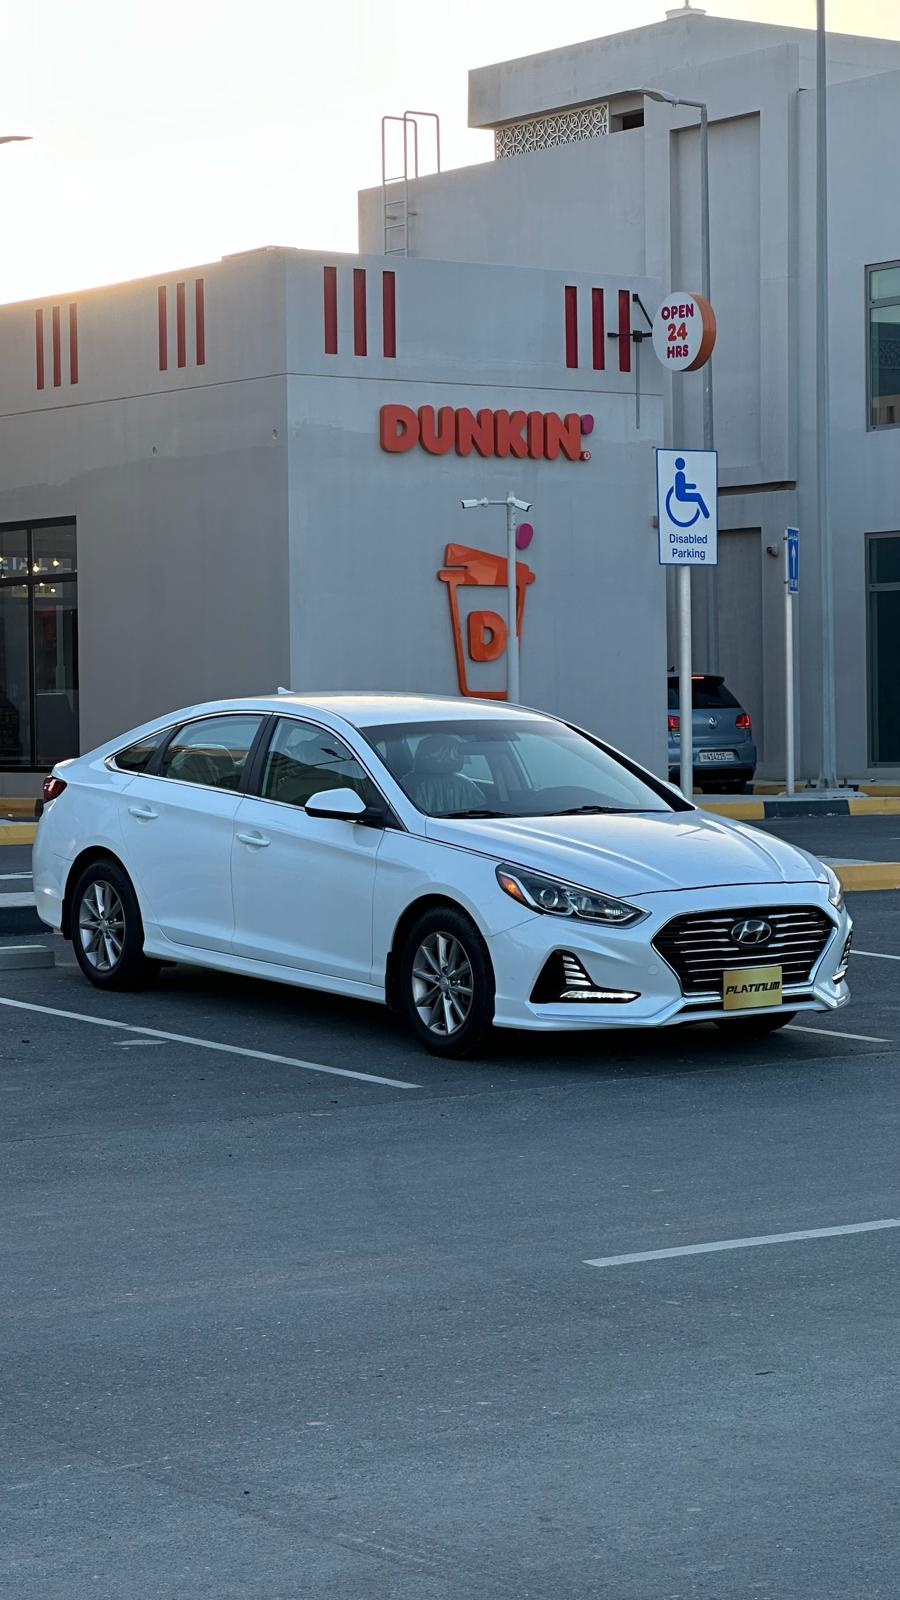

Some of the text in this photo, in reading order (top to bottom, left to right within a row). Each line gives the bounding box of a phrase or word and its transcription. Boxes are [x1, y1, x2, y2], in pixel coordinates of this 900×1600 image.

[661, 303, 694, 320] OPEN
[667, 322, 688, 341] 24
[667, 345, 689, 359] HRS
[669, 533, 708, 544] Disabled
[672, 548, 706, 560] Parking
[467, 610, 509, 662] D
[726, 981, 780, 995] PLATINUM
